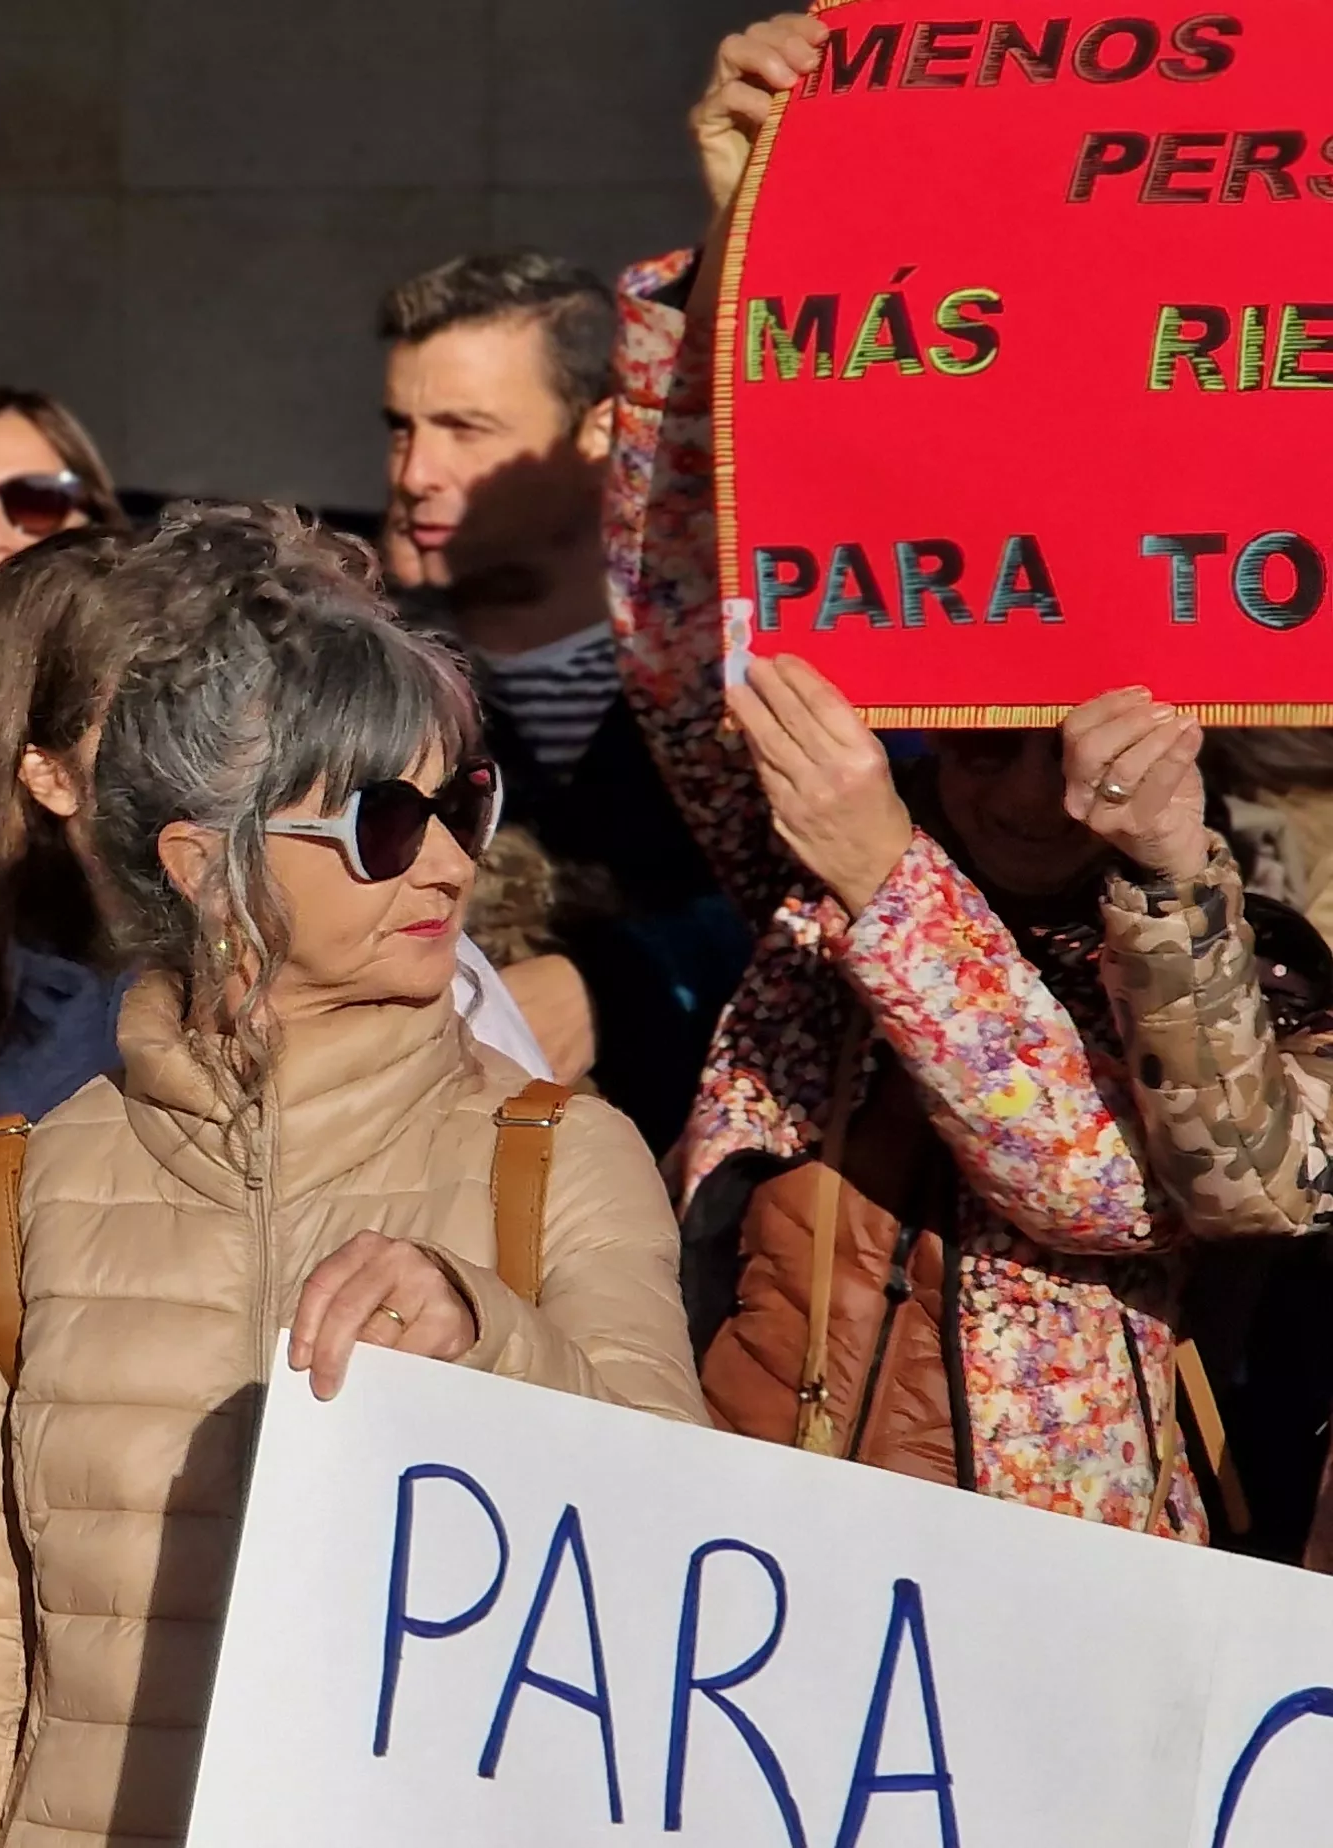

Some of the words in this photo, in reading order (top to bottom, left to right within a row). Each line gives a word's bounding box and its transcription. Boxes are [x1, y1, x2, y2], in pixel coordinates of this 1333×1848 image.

[798, 13, 1243, 100] MENOS
[743, 265, 1004, 382] MÁS
[752, 533, 1065, 632] PARA
[1140, 529, 1328, 631] TO
[373, 1463, 960, 1848] PARA
